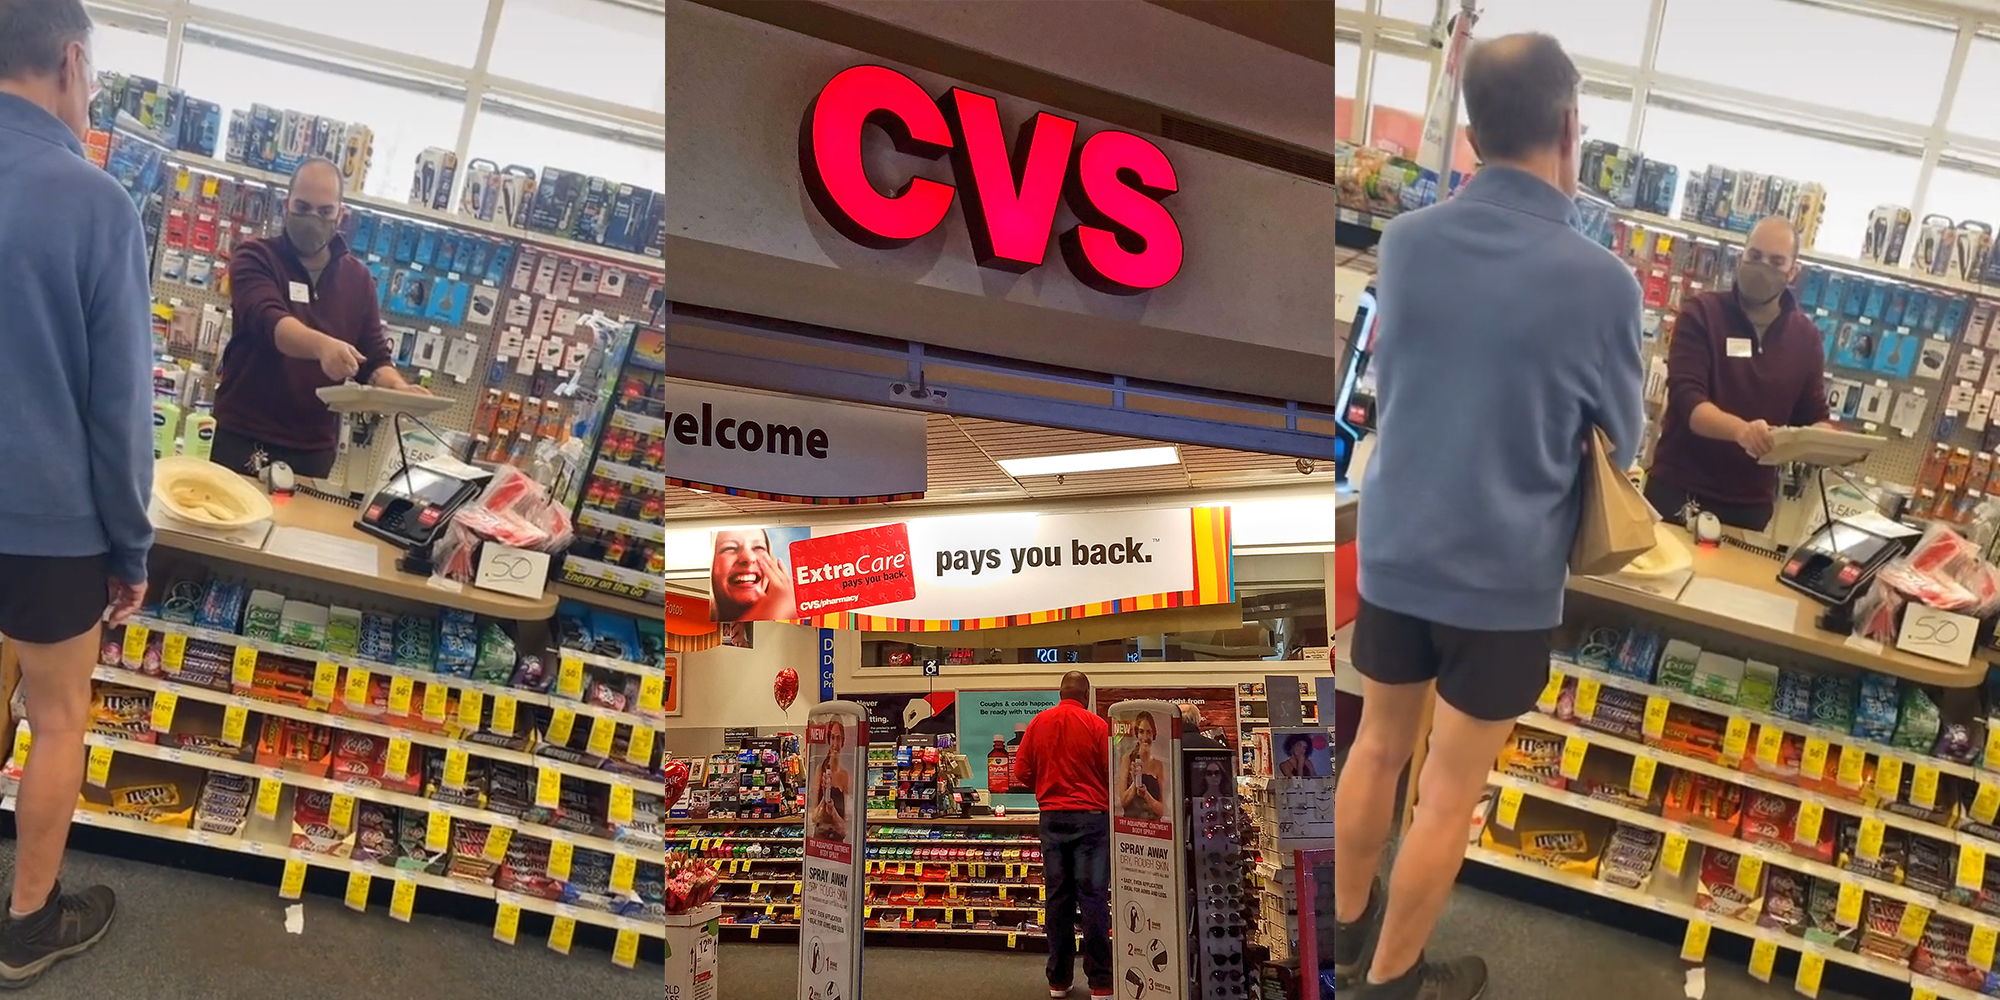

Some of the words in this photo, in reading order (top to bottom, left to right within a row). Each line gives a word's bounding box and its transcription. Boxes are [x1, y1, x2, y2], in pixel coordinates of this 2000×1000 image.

[804, 65, 1184, 294] CVS
[935, 546, 1002, 577] pays
[1011, 543, 1062, 574] you
[1071, 536, 1153, 566] back.
[484, 552, 533, 578] .50
[564, 571, 597, 588] Energy
[598, 580, 611, 591] on
[612, 580, 629, 594] the
[629, 586, 644, 598] Go
[842, 578, 863, 590] pays
[865, 575, 881, 587] you
[883, 569, 908, 581] back.
[800, 594, 859, 611] CVS/pharmacy
[1907, 615, 1960, 642] .50
[155, 701, 172, 711] free
[980, 700, 1003, 708] Coughs
[1029, 700, 1055, 708] happen.
[990, 708, 1007, 716] ready
[810, 728, 826, 741] NEW
[1114, 723, 1131, 735] NEW
[90, 756, 108, 766] free
[1120, 841, 1144, 856] SPRAY
[1147, 846, 1169, 860] AWAY
[1120, 854, 1133, 866] DRY,
[1134, 856, 1154, 869] ROUGH
[1155, 859, 1170, 872] SKIN
[809, 867, 829, 883] SPRAY
[830, 871, 849, 888] AWAY
[1142, 881, 1164, 890] APPLICATION
[836, 888, 848, 902] SKIN
[1146, 918, 1151, 931] 1
[1127, 943, 1134, 956] 2
[1148, 978, 1155, 991] 3
